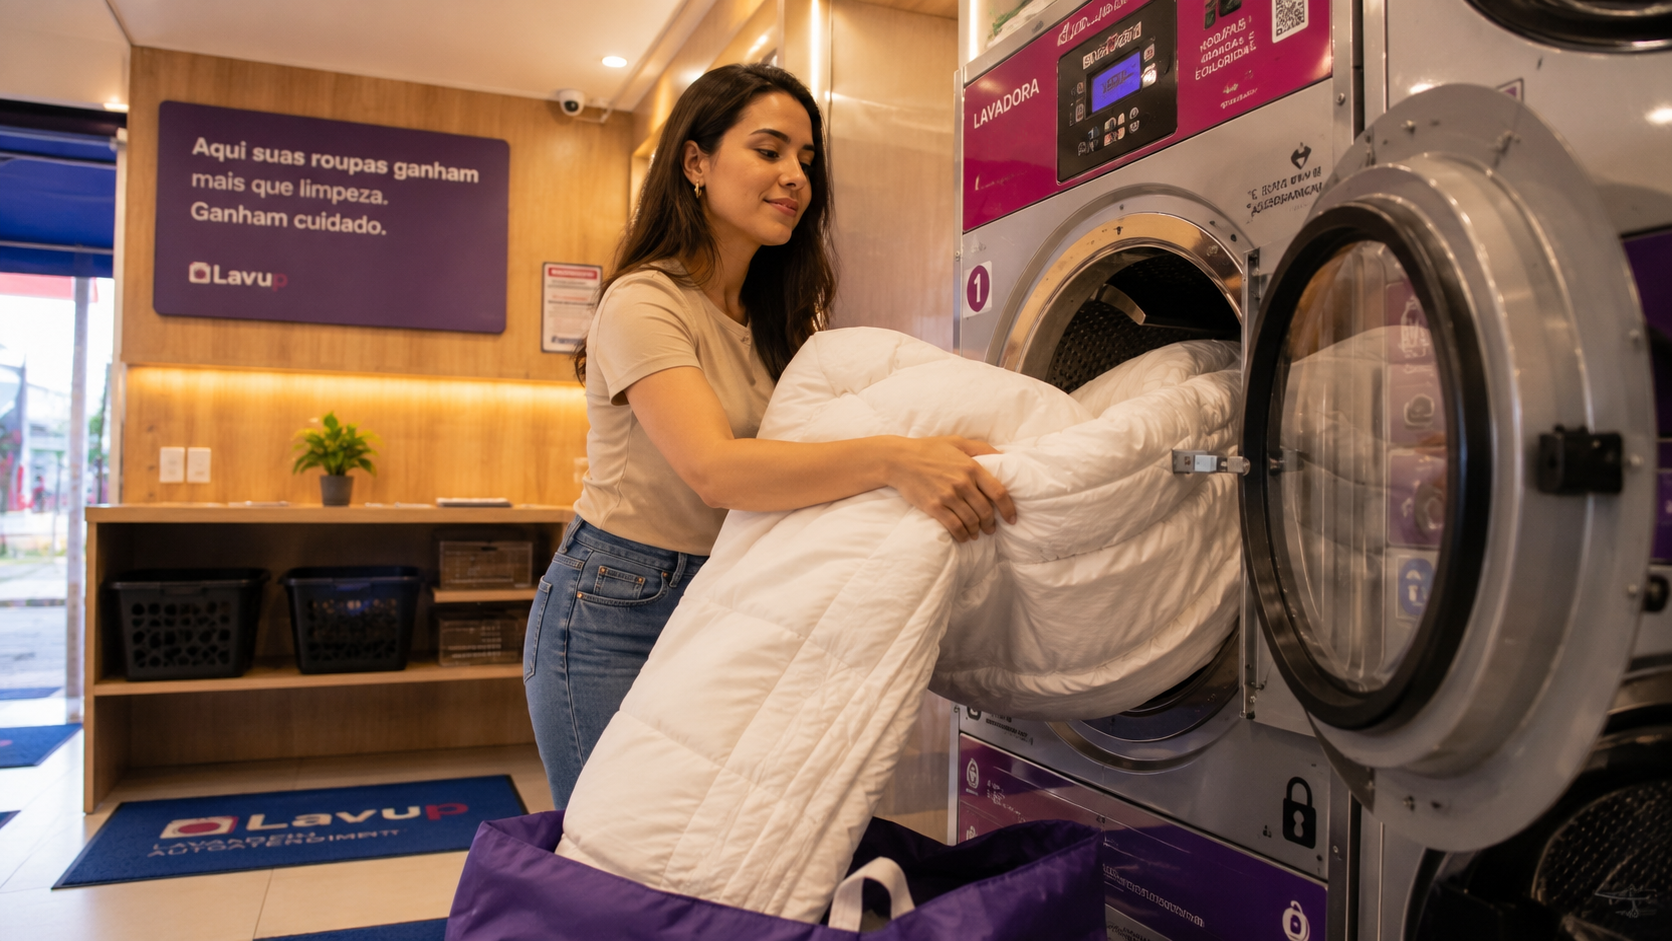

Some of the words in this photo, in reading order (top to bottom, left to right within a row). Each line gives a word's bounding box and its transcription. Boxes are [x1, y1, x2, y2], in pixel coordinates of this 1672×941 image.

[973, 78, 1040, 129] LAVADORA
[192, 137, 247, 162] Aqui
[252, 147, 305, 166] suas
[311, 154, 388, 176] roupas
[393, 162, 479, 184] ganham
[192, 172, 246, 191] mais
[251, 179, 294, 199] que
[299, 179, 388, 205] limpeza.
[190, 201, 288, 228] Ganham
[293, 211, 387, 236] cuidado.
[213, 264, 288, 292] Lavup
[973, 273, 981, 303] 1
[246, 803, 469, 832] Lavup
